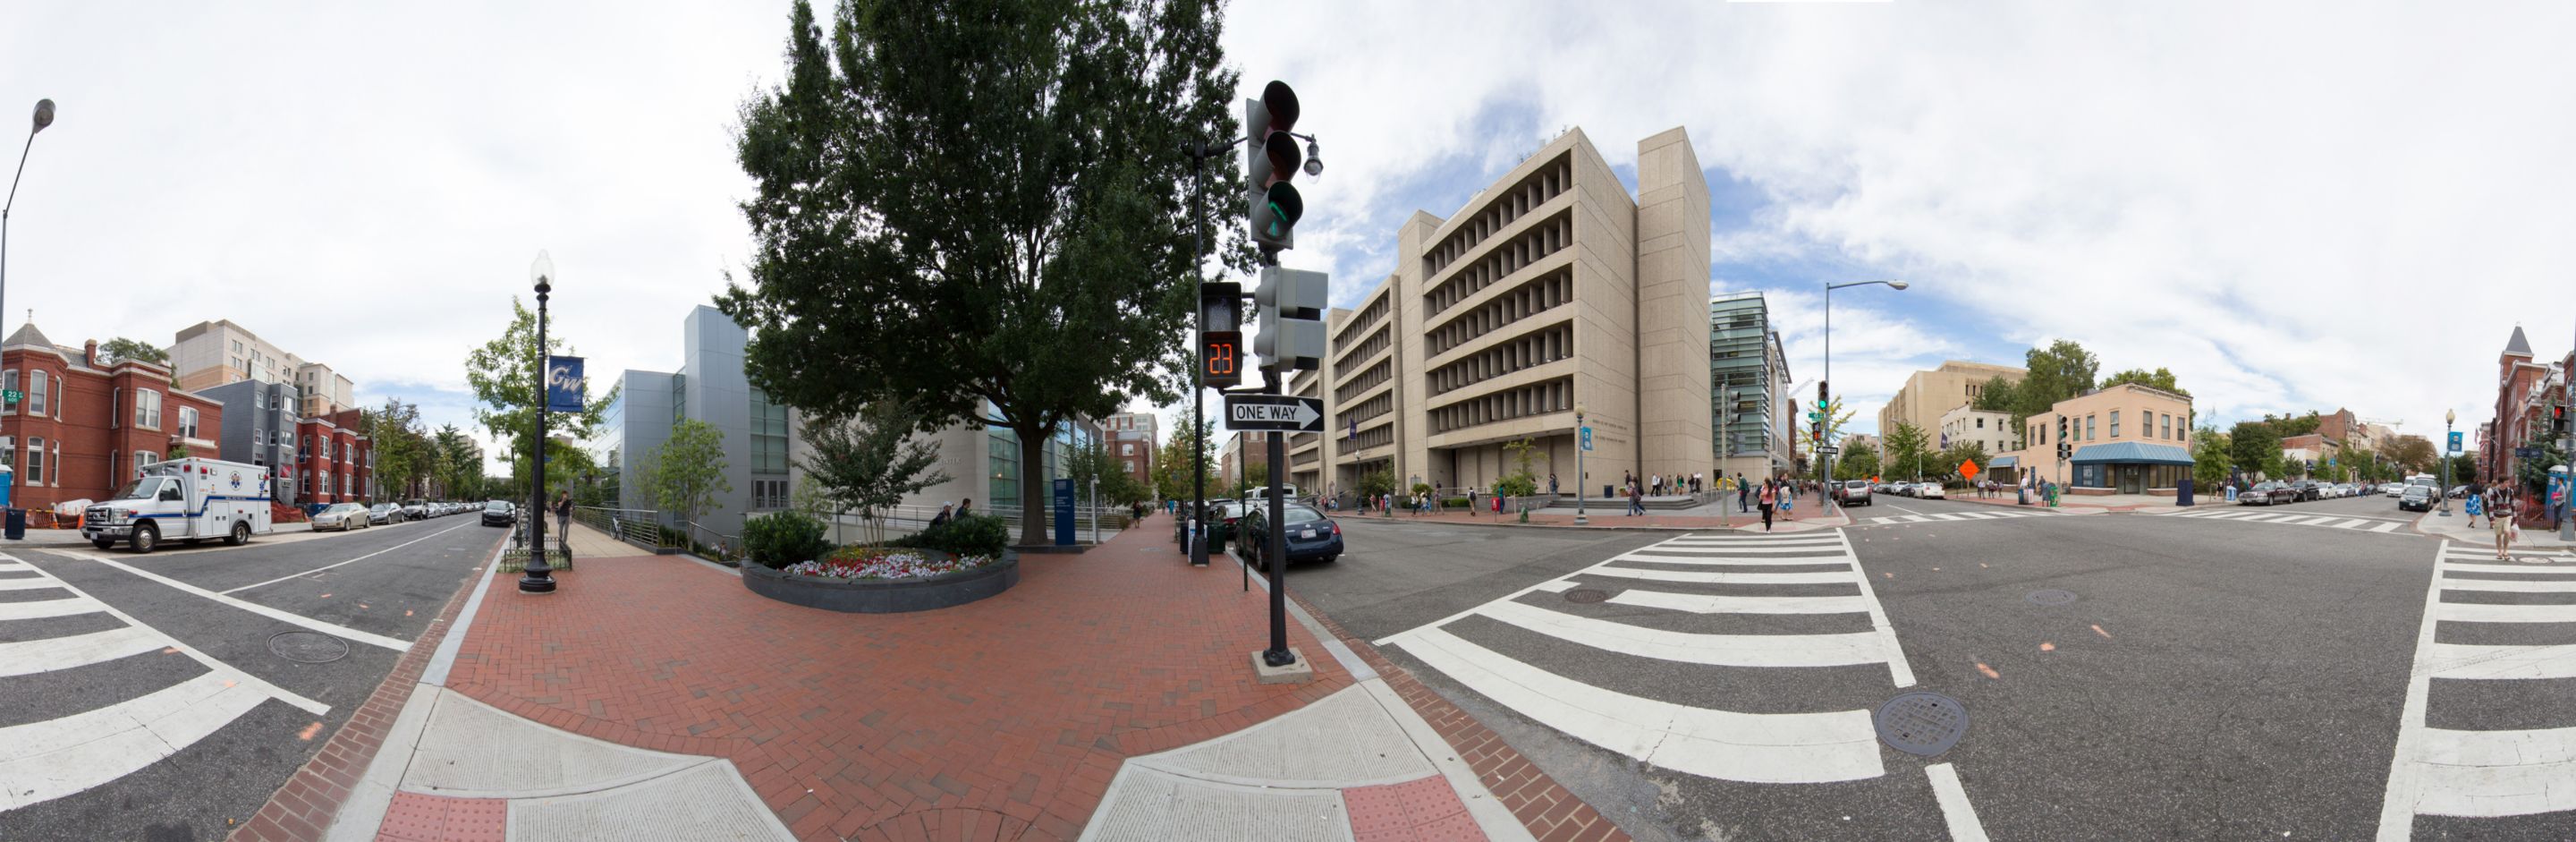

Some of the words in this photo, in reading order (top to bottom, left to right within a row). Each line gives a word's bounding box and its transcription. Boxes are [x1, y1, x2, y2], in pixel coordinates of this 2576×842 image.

[1209, 344, 1233, 374] 23
[549, 365, 582, 393] GW
[1236, 405, 1265, 420] ONE
[1269, 406, 1297, 421] WAY
